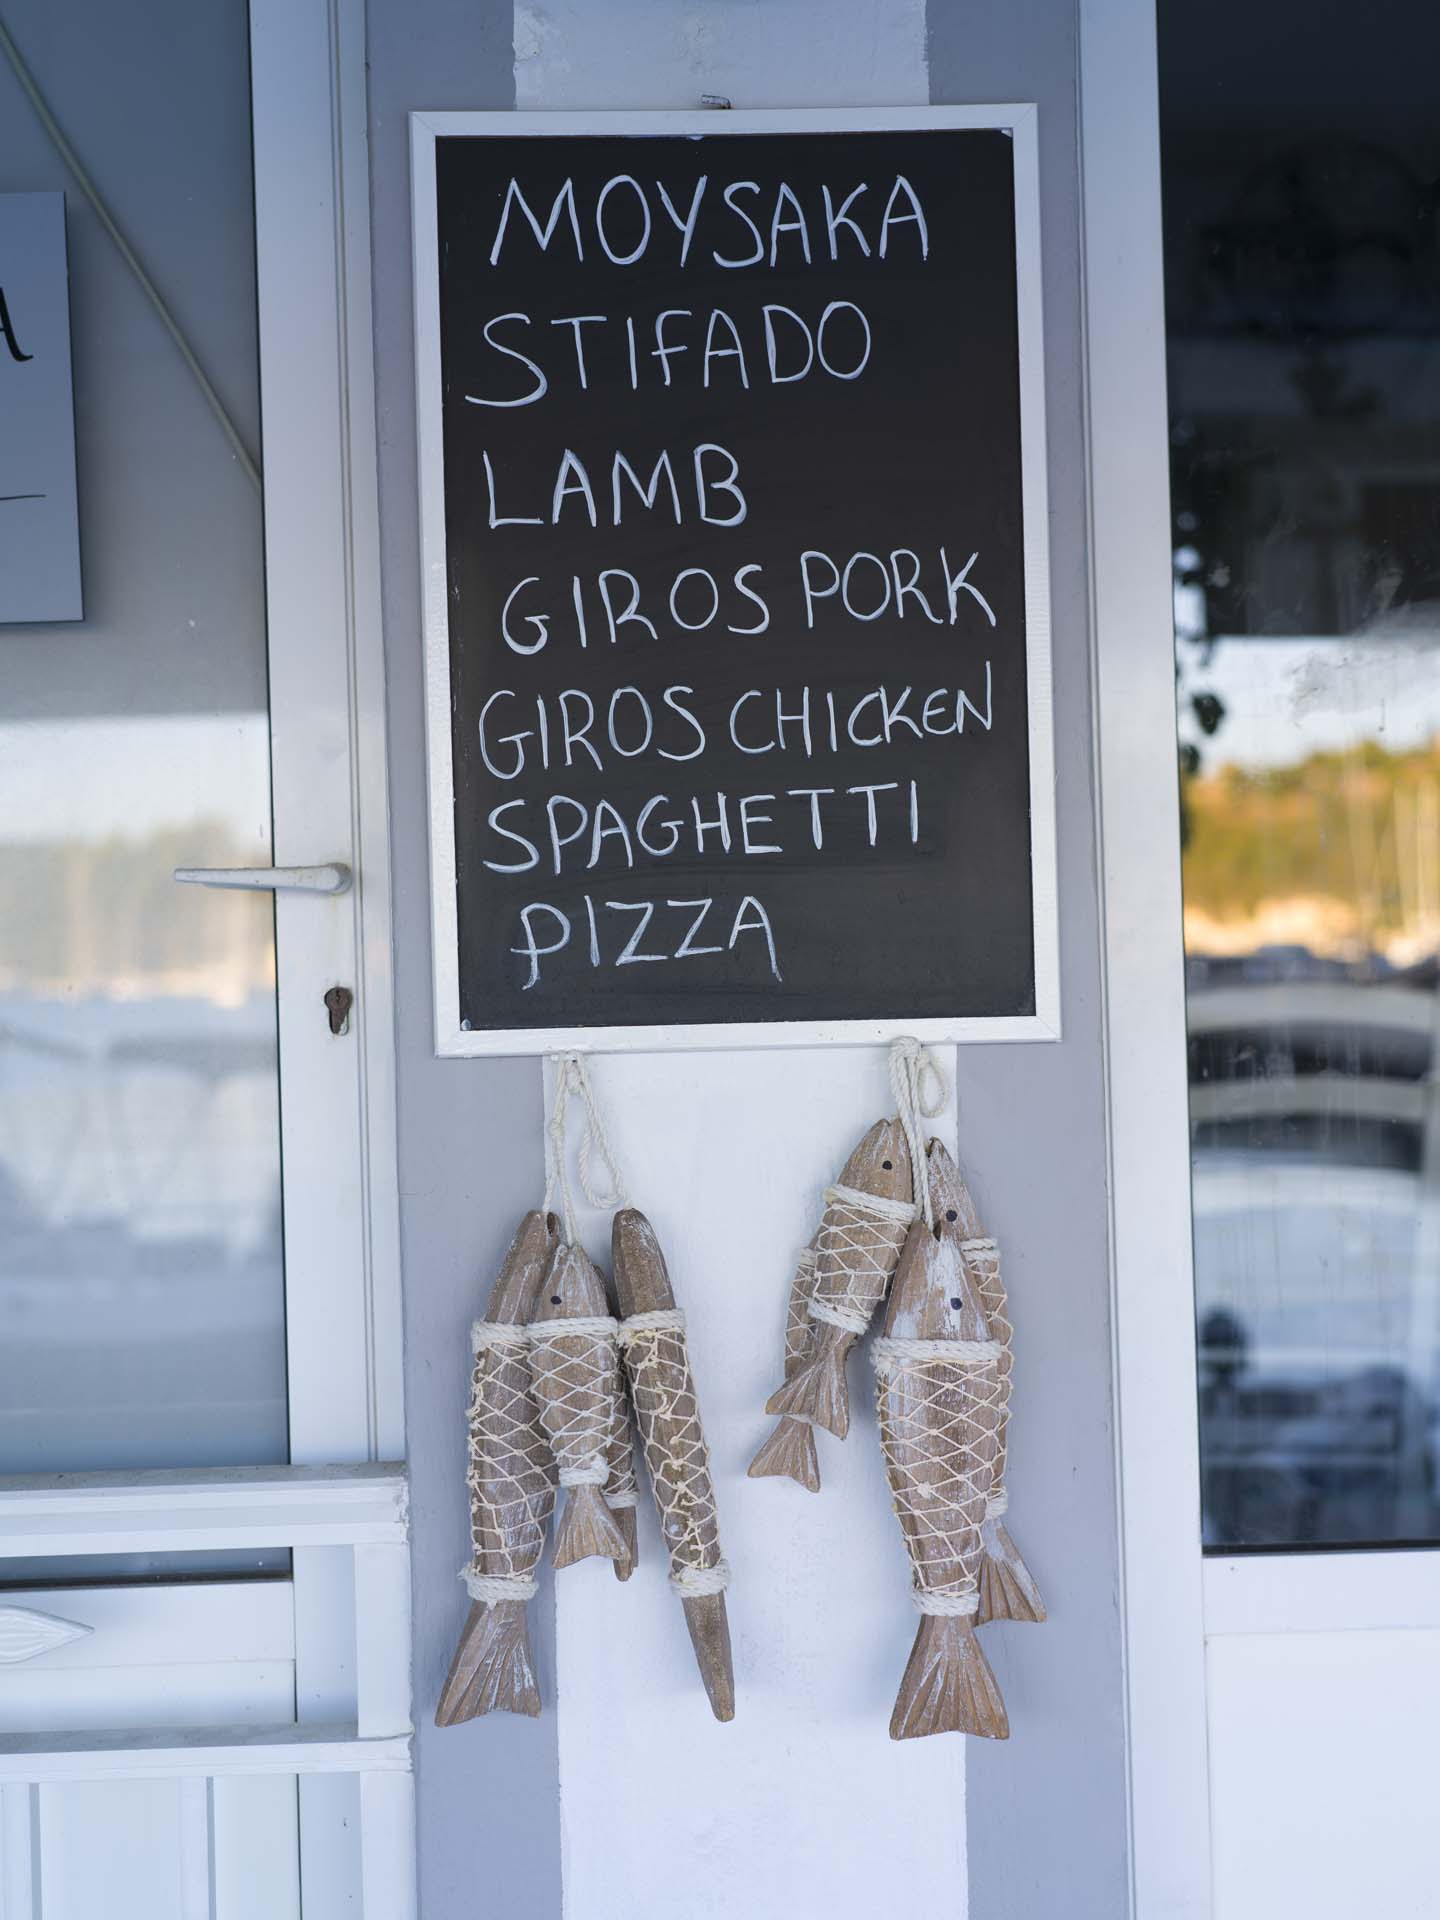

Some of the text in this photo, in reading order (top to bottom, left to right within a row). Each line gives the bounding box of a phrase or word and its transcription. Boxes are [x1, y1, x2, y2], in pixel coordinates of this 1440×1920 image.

[489, 174, 930, 268] MOYSAKA
[464, 301, 871, 407] STIFADO
[482, 443, 748, 528] LAMB
[501, 546, 997, 655] GIROS PORK
[478, 660, 993, 780] GIROS CHICKEN
[482, 779, 919, 875] SPAGHETTI
[510, 894, 783, 991] PIZZA
